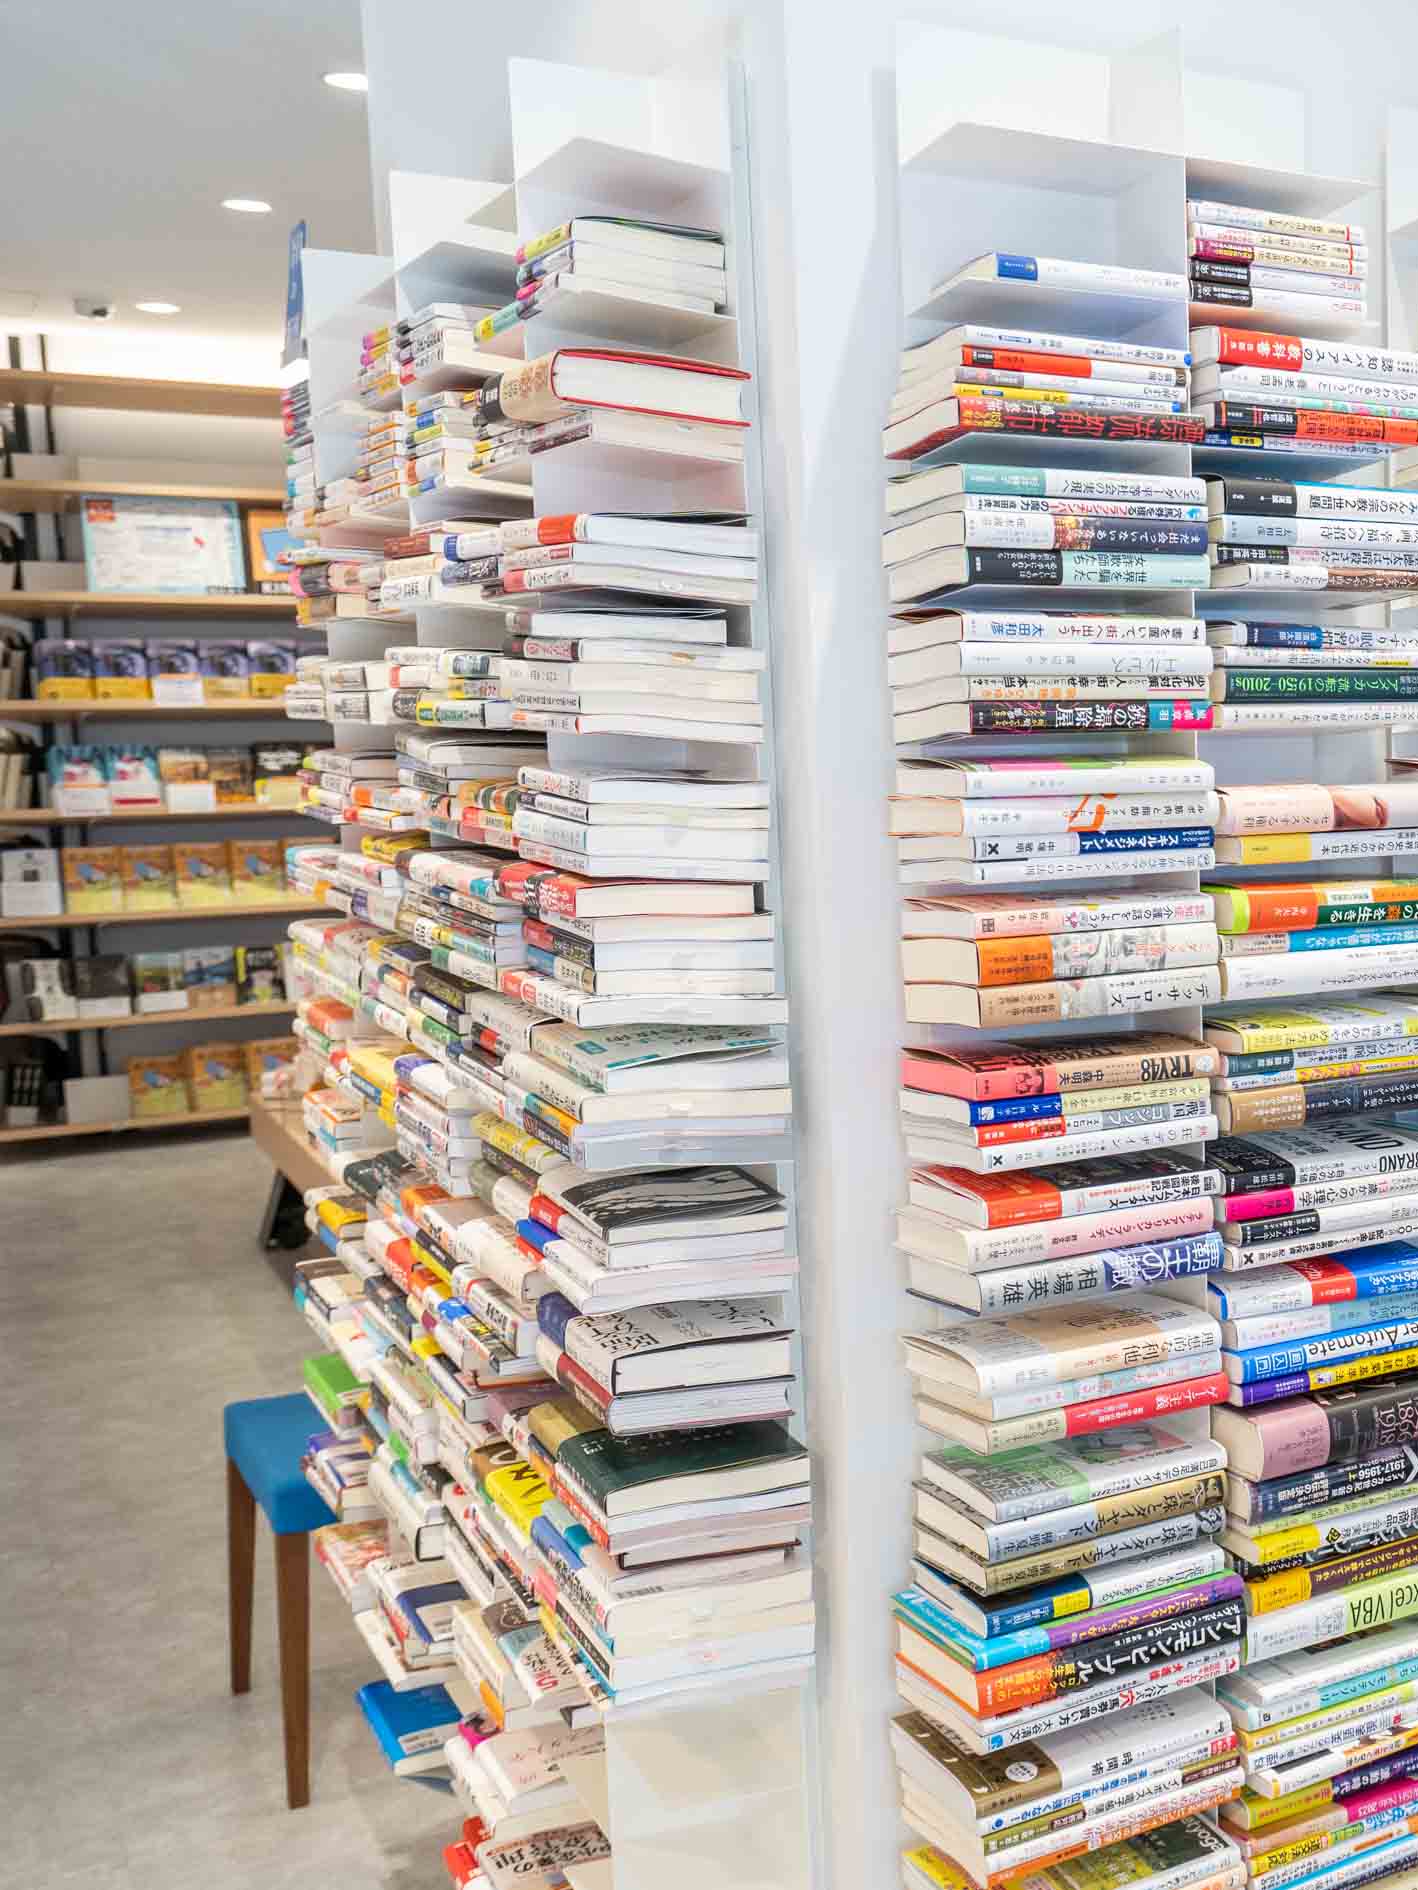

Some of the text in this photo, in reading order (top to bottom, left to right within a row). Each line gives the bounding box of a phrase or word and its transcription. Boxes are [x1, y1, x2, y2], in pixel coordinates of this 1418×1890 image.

[1308, 493, 1417, 514] みんなの宗教2世問題
[1073, 554, 1144, 566] 女詐欺師たち
[1073, 568, 1145, 582] 世界を騙した
[1058, 624, 1182, 640] 書を置いて、街へ出よう
[1354, 678, 1398, 690] アメリカ
[1080, 834, 1179, 849] スキルマネジメント
[1139, 1054, 1190, 1082] TRY48
[1109, 1185, 1200, 1208] 日本ハムファイターズ
[1002, 1239, 1219, 1304] 覇王の轍 相場英雄
[1304, 1326, 1399, 1362] Automate
[1375, 1406, 1394, 1446] 1918
[1396, 1398, 1412, 1442] 1866
[1349, 1591, 1385, 1629] VBA
[1077, 1614, 1241, 1683] アンコモン・ピープル
